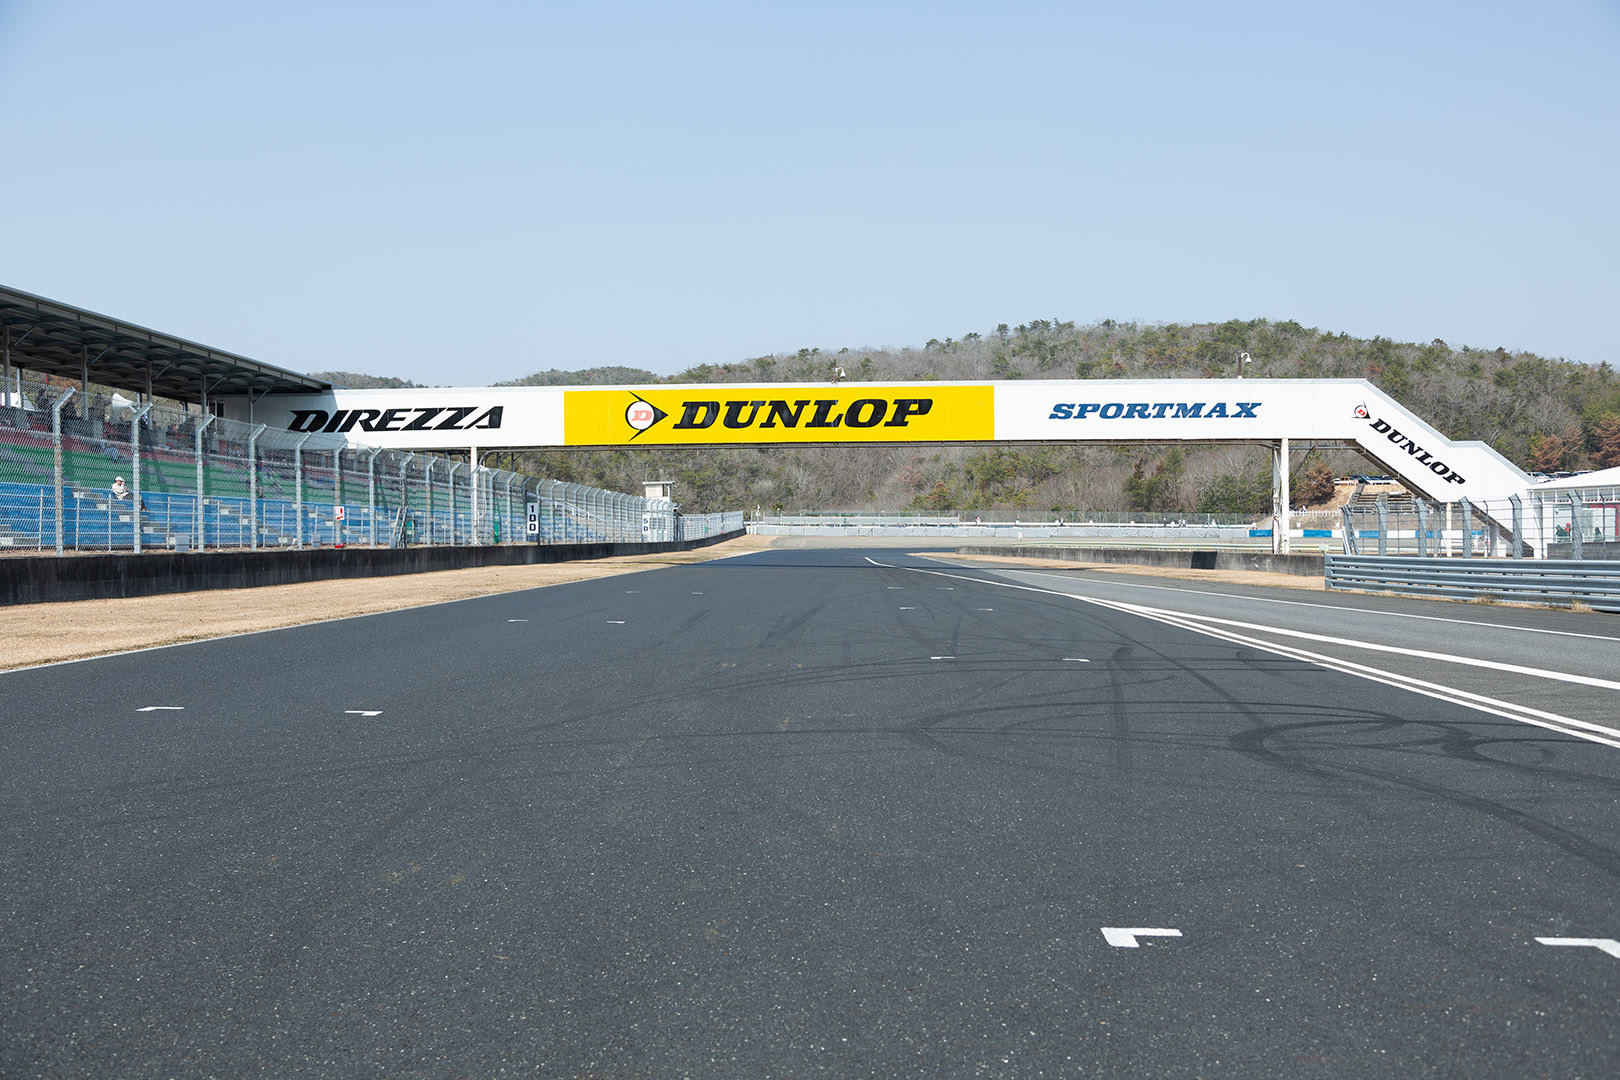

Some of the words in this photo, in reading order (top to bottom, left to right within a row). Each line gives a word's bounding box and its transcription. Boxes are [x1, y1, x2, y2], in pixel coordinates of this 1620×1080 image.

[287, 406, 504, 433] DIREZZA
[672, 398, 933, 430] DUNLOP
[1048, 402, 1262, 420] SPORTMAX
[1369, 418, 1466, 485] DUNLOP
[529, 504, 537, 532] 100
